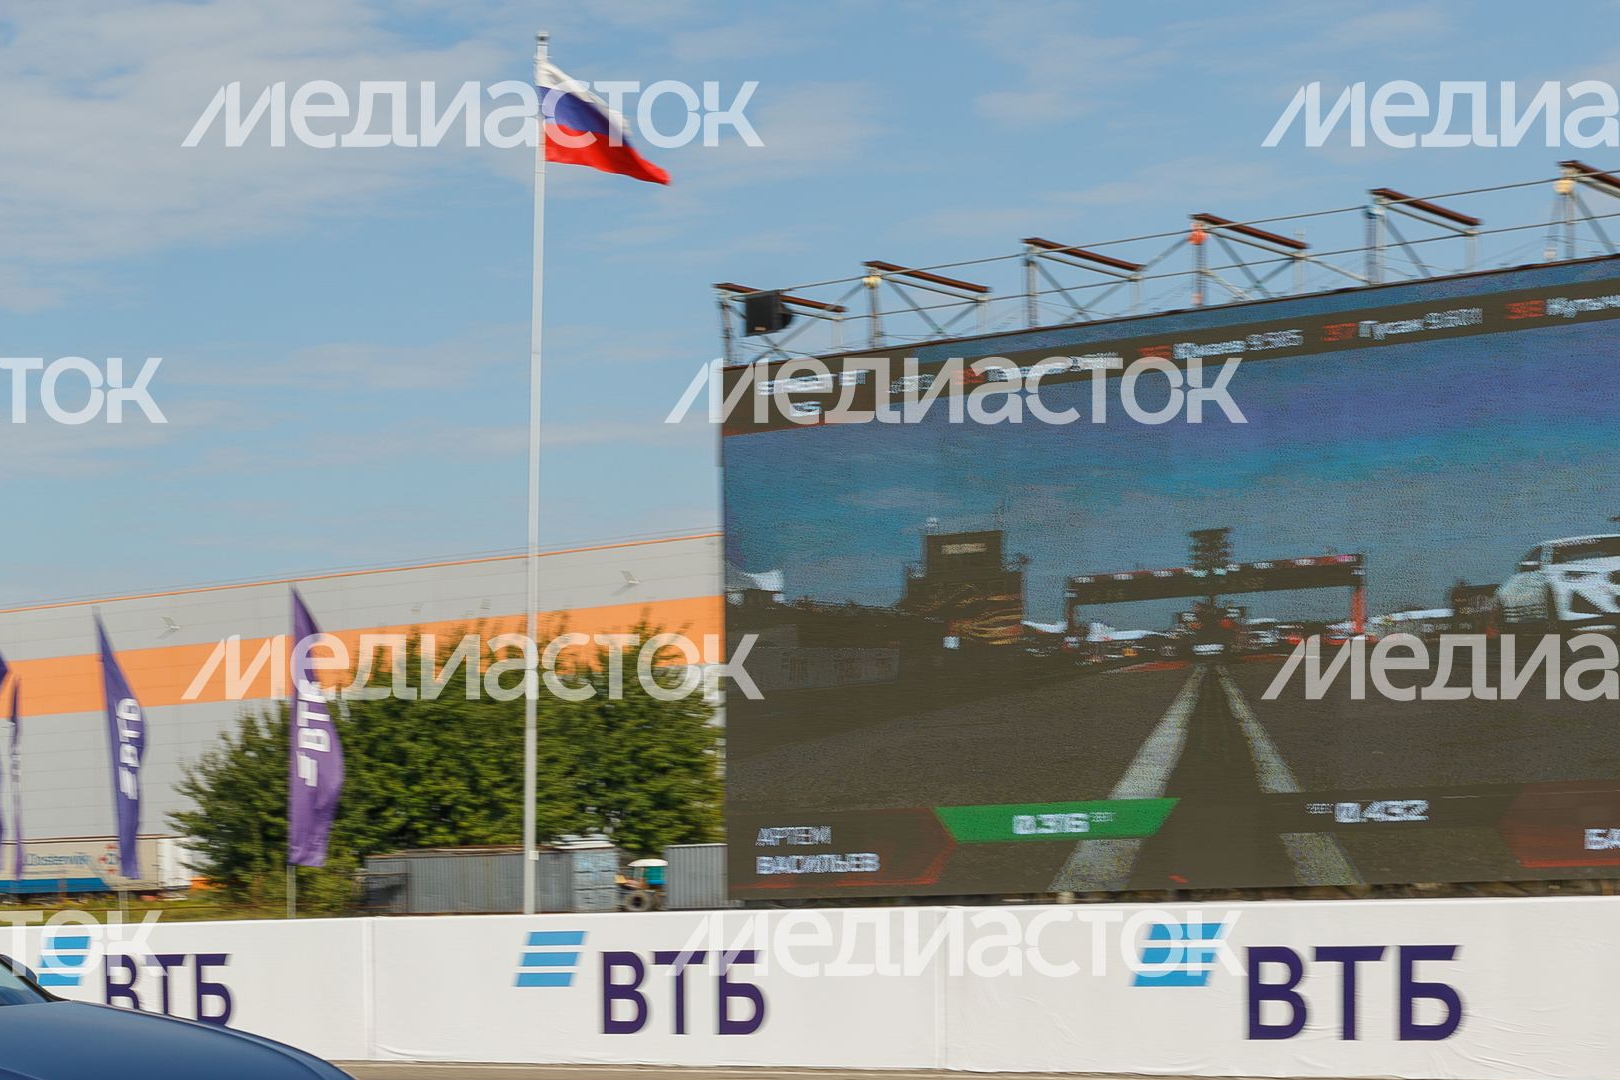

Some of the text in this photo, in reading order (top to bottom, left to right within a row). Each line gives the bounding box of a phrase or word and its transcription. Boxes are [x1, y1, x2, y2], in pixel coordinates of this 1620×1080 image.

[102, 953, 235, 1026] ВТБ
[600, 949, 767, 1036] ВТБ
[1245, 945, 1466, 1041] ВТБ
